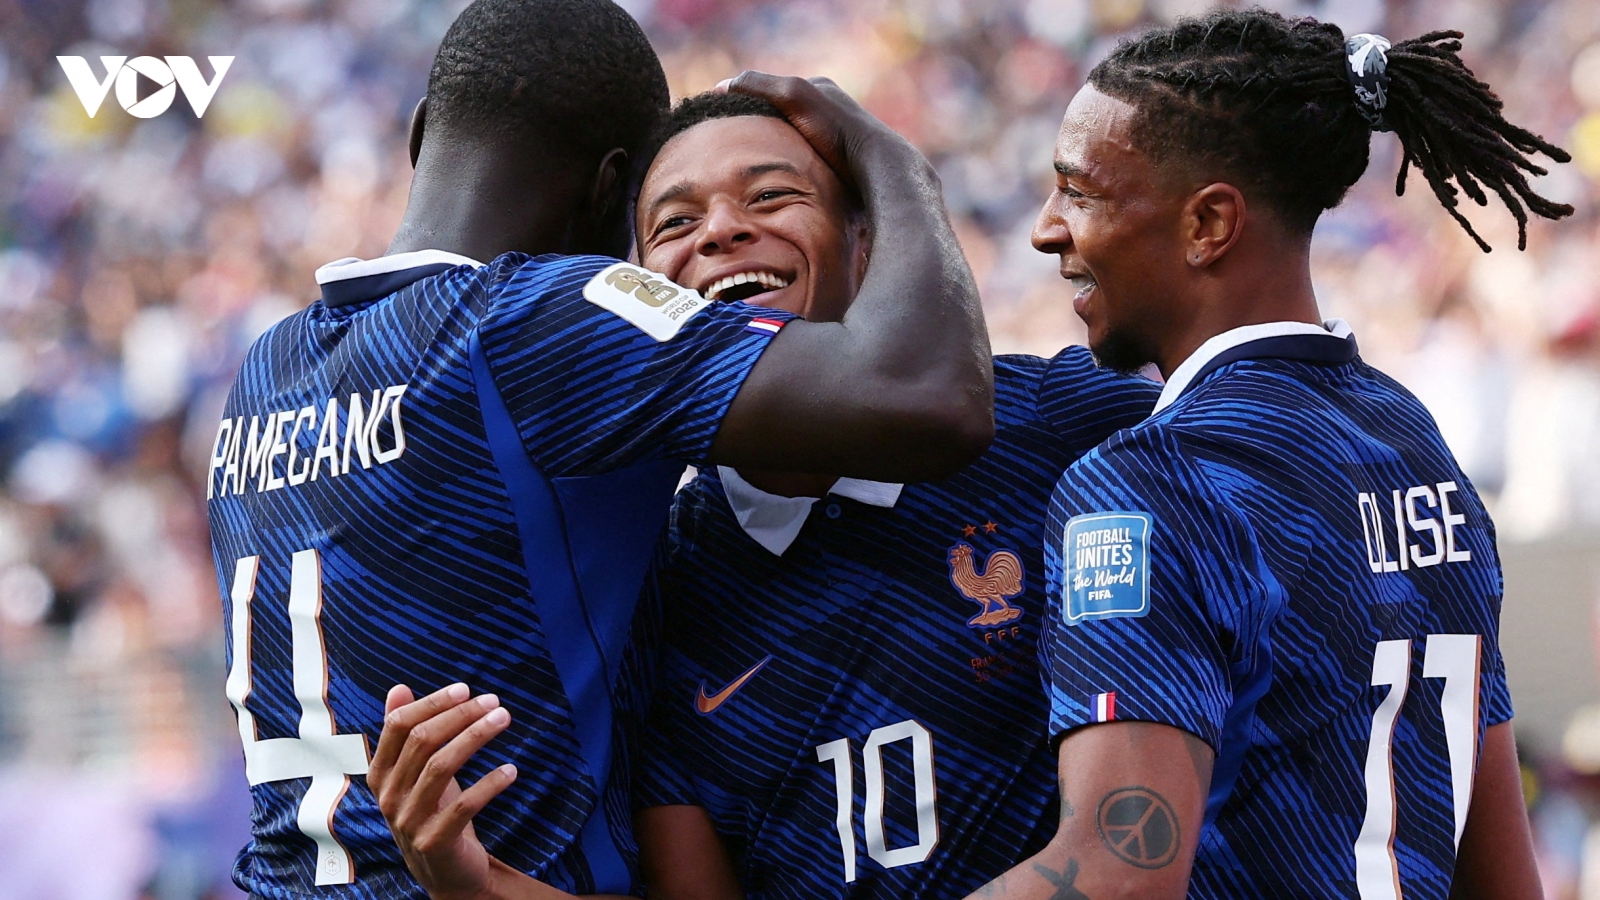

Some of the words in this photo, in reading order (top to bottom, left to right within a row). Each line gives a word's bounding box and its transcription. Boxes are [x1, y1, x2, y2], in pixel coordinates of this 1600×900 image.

[661, 298, 681, 315] WORLD
[679, 294, 689, 304] CUP
[668, 299, 698, 321] 2026
[207, 384, 408, 501] PAMECANO
[1076, 527, 1132, 549] FOOTBALL
[1358, 480, 1472, 574] OLISE
[1076, 543, 1133, 571] UNITES
[1073, 571, 1092, 592] the
[1094, 566, 1136, 588] World
[1088, 589, 1112, 601] FIFA
[226, 548, 370, 886] 4
[1354, 633, 1482, 900] 11
[815, 719, 940, 883] 10
